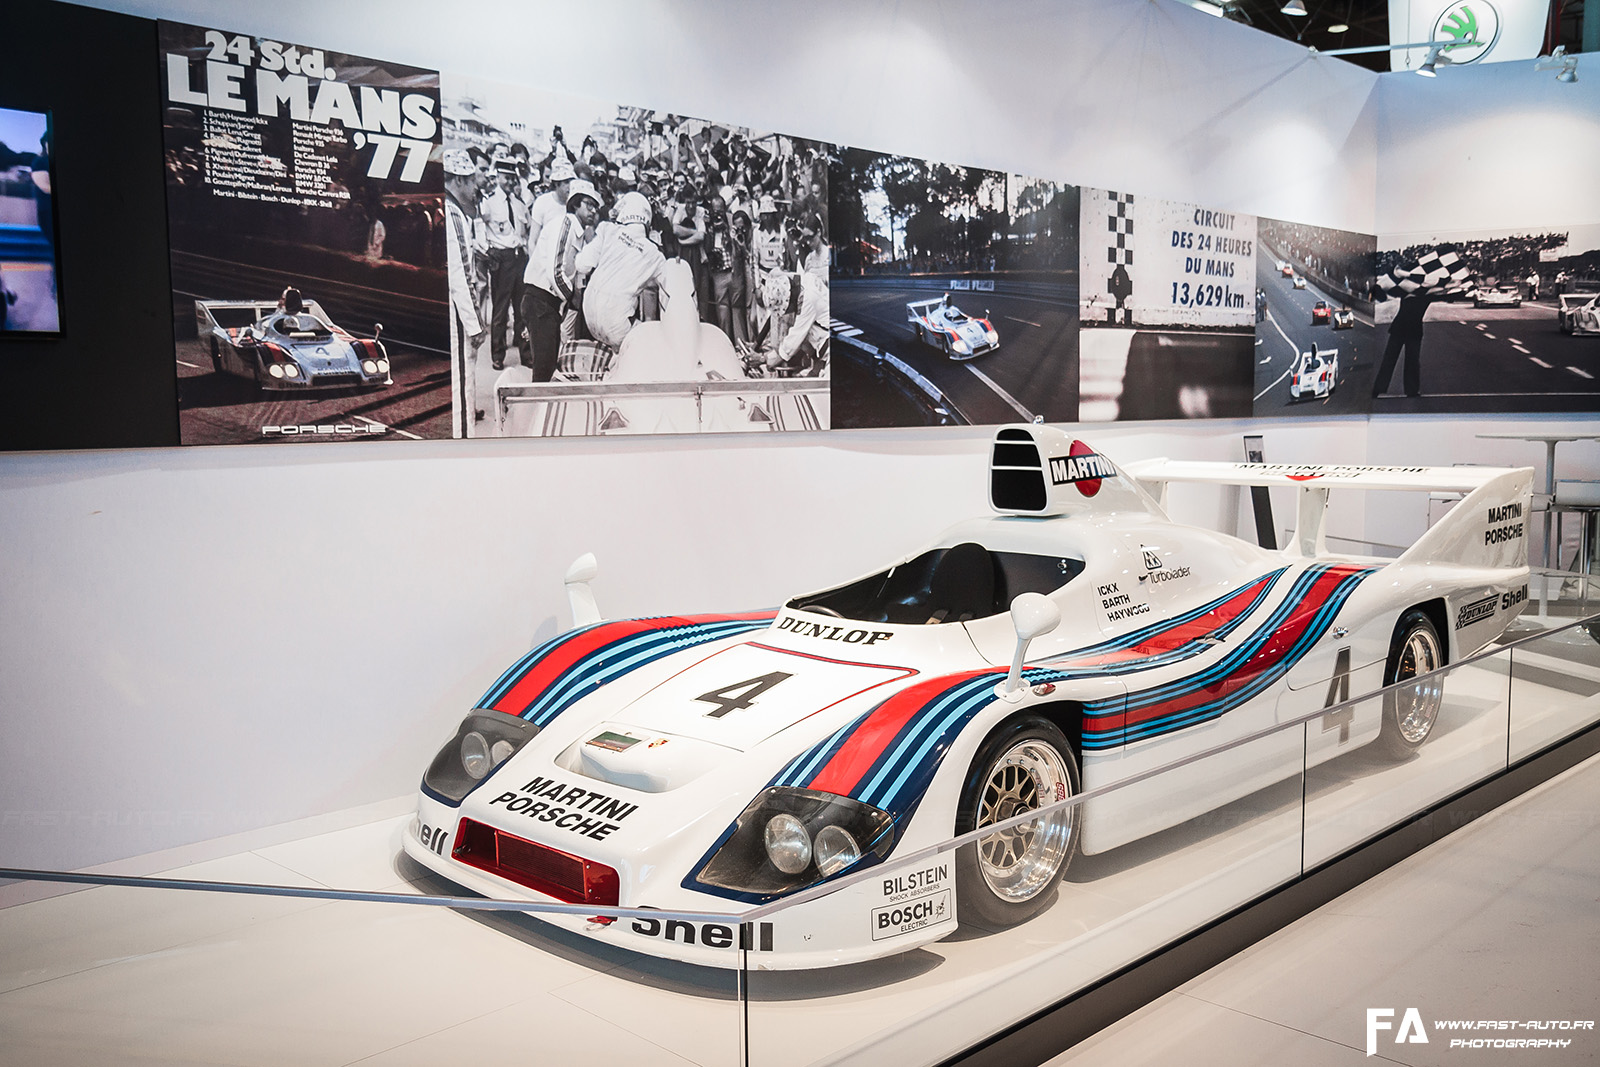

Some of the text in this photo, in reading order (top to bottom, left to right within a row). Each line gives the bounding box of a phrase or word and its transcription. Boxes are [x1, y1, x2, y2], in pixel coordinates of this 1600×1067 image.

[205, 30, 337, 80] 24 Std.
[167, 53, 437, 140] LE MANS
[213, 189, 235, 198] Martini
[1193, 208, 1236, 231] CIRCUIT
[1171, 231, 1252, 257] DES 24 HEURES
[1185, 257, 1235, 278] DU MANS
[1171, 282, 1223, 308] 13,629
[262, 425, 386, 435] PORSCHE
[1051, 455, 1116, 482] MARTINI
[1488, 502, 1522, 524] MARTINI
[1485, 523, 1523, 546] PORSCHE
[1097, 583, 1119, 596] ICKX
[1102, 594, 1131, 609] BARTH
[1501, 584, 1528, 610] Shell
[777, 616, 894, 645] DUNLOP
[693, 670, 795, 718] 4
[1322, 646, 1355, 747] 4
[519, 776, 639, 822] MARTINI
[489, 791, 620, 841] PORSCHE
[883, 864, 948, 896] BILSTEIN
[910, 883, 940, 897] ABSORBERS
[889, 892, 909, 902] SHOCK
[878, 900, 933, 929] BOSCH
[901, 918, 928, 932] ELECTRIC
